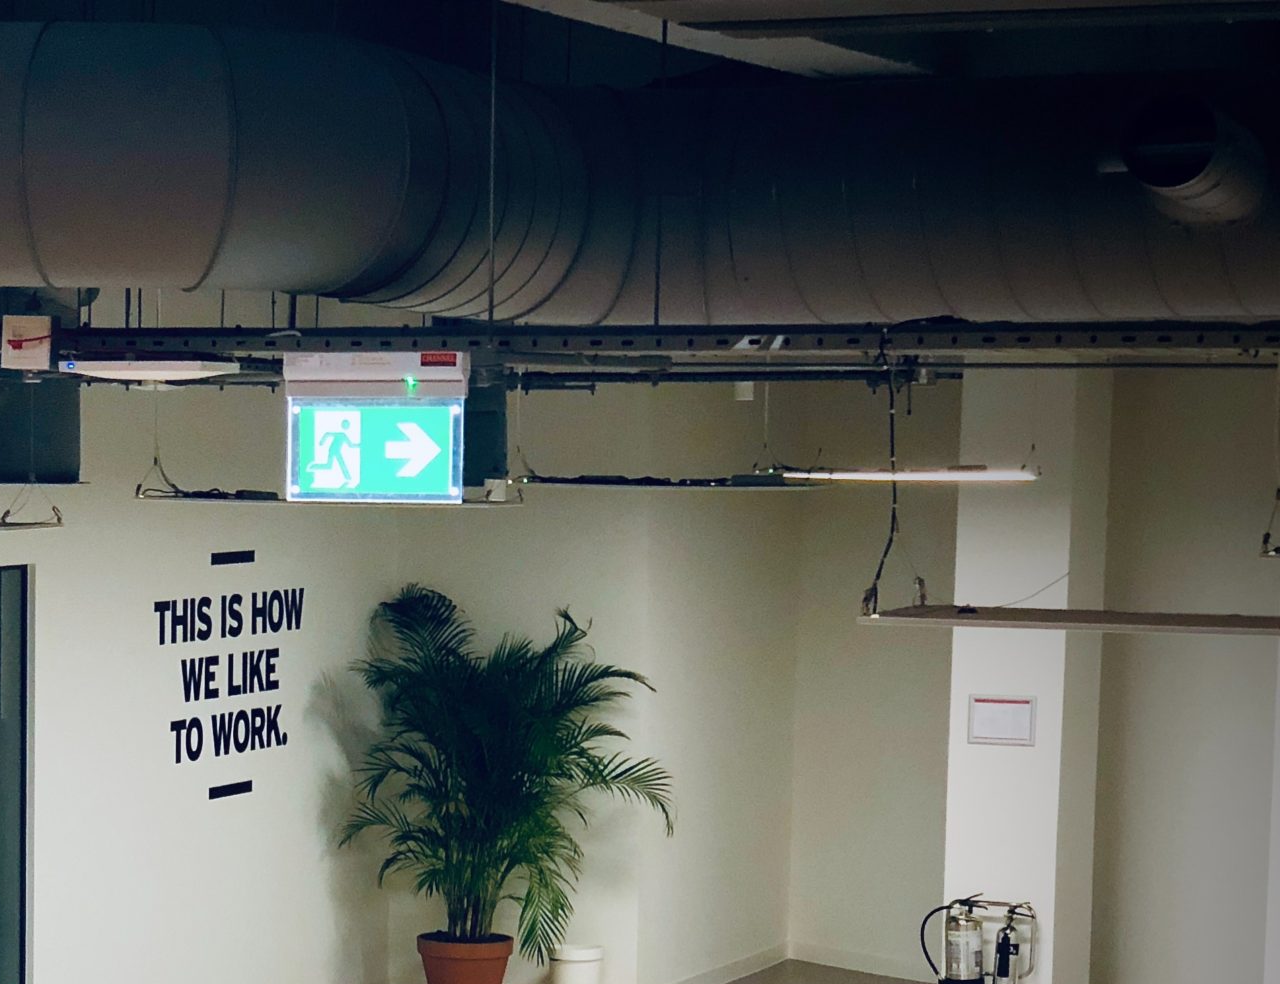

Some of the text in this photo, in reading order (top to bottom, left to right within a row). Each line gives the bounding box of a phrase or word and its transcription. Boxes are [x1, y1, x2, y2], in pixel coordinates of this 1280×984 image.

[154, 588, 304, 645] THIS IS HOW
[181, 648, 279, 702] WE LIKE
[170, 704, 288, 764] TO WORK.
